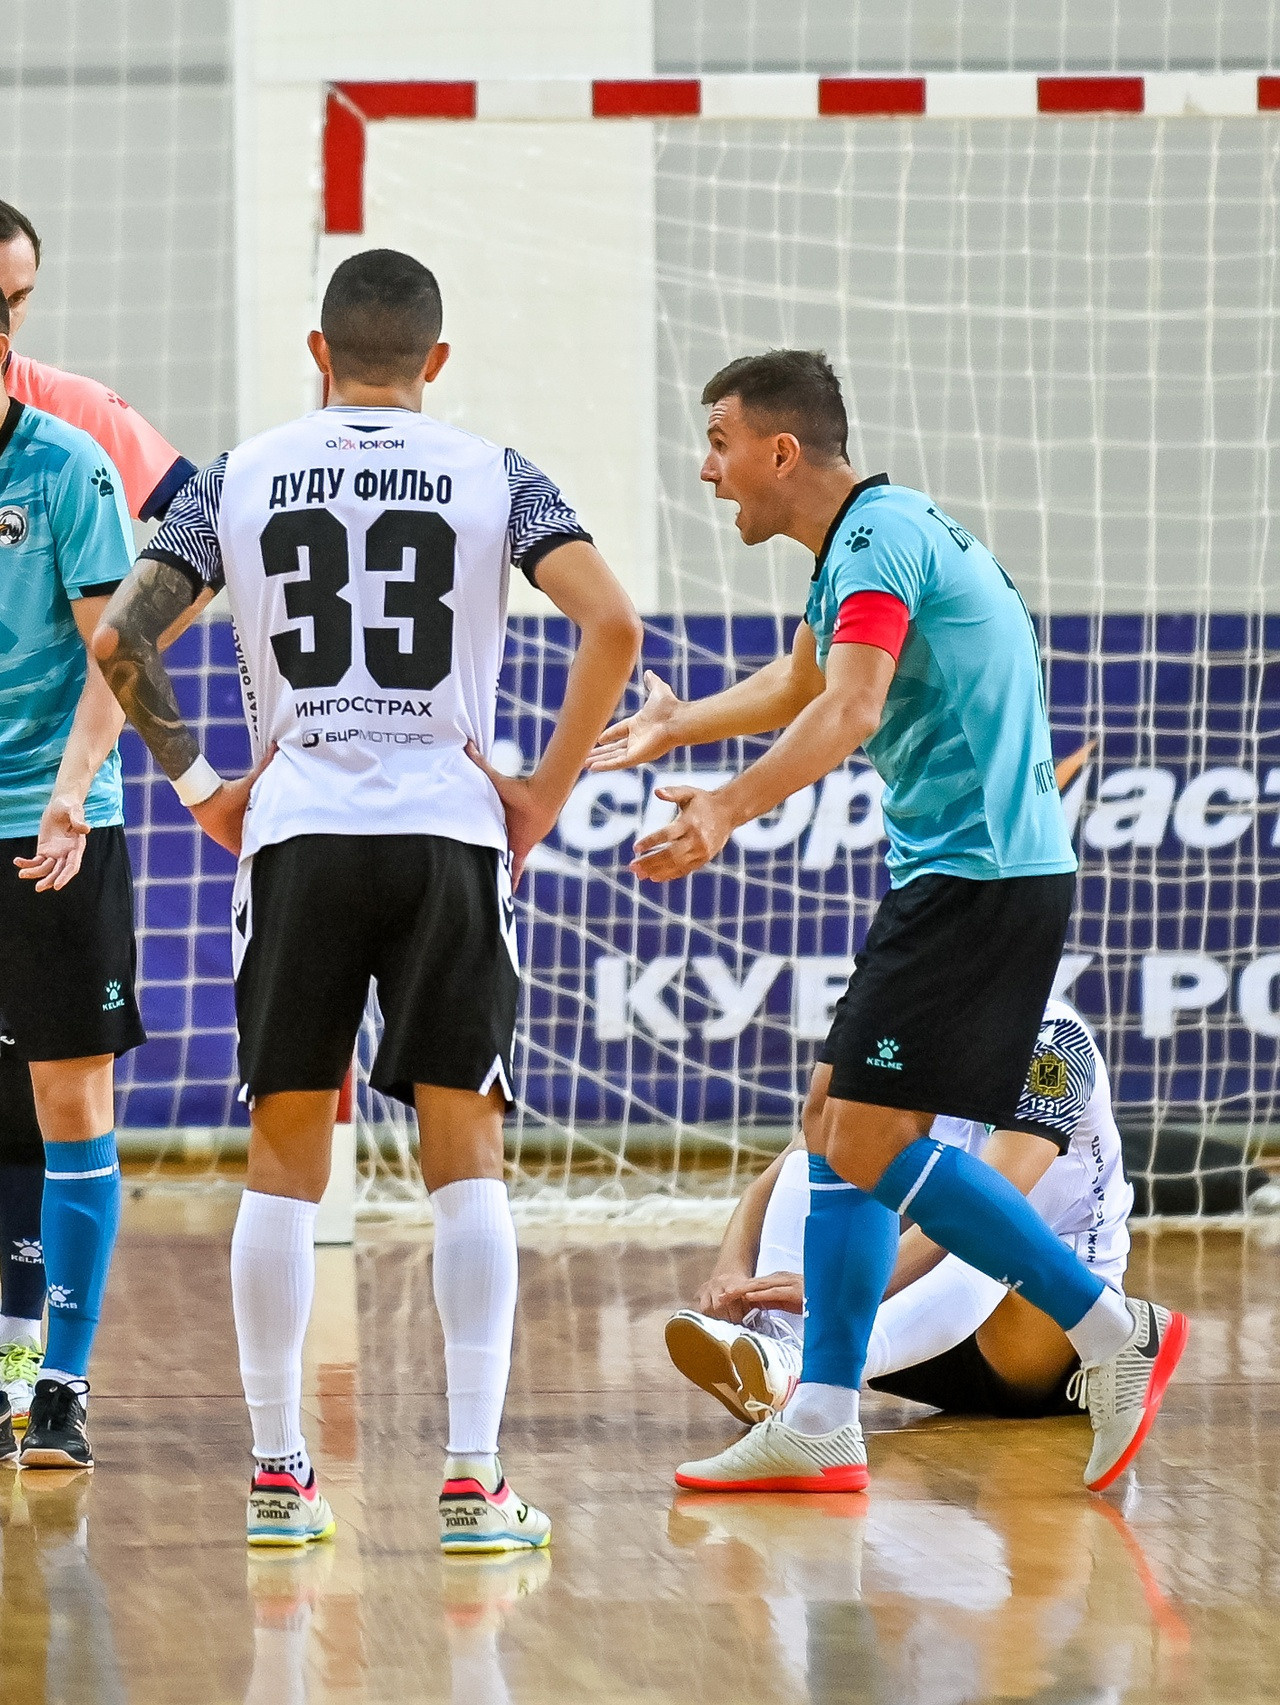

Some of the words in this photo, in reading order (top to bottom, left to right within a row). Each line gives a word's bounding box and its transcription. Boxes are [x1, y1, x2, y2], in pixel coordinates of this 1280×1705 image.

[359, 439, 405, 450] ЮКОН
[269, 467, 346, 509] ДУДУ
[354, 469, 453, 505] ФИЛЬО
[260, 508, 457, 691] 33
[295, 696, 433, 719] ИНГОССТРАХ
[102, 998, 125, 1011] KELME
[866, 1056, 904, 1071] KELME
[1030, 1097, 1061, 1116] 1221
